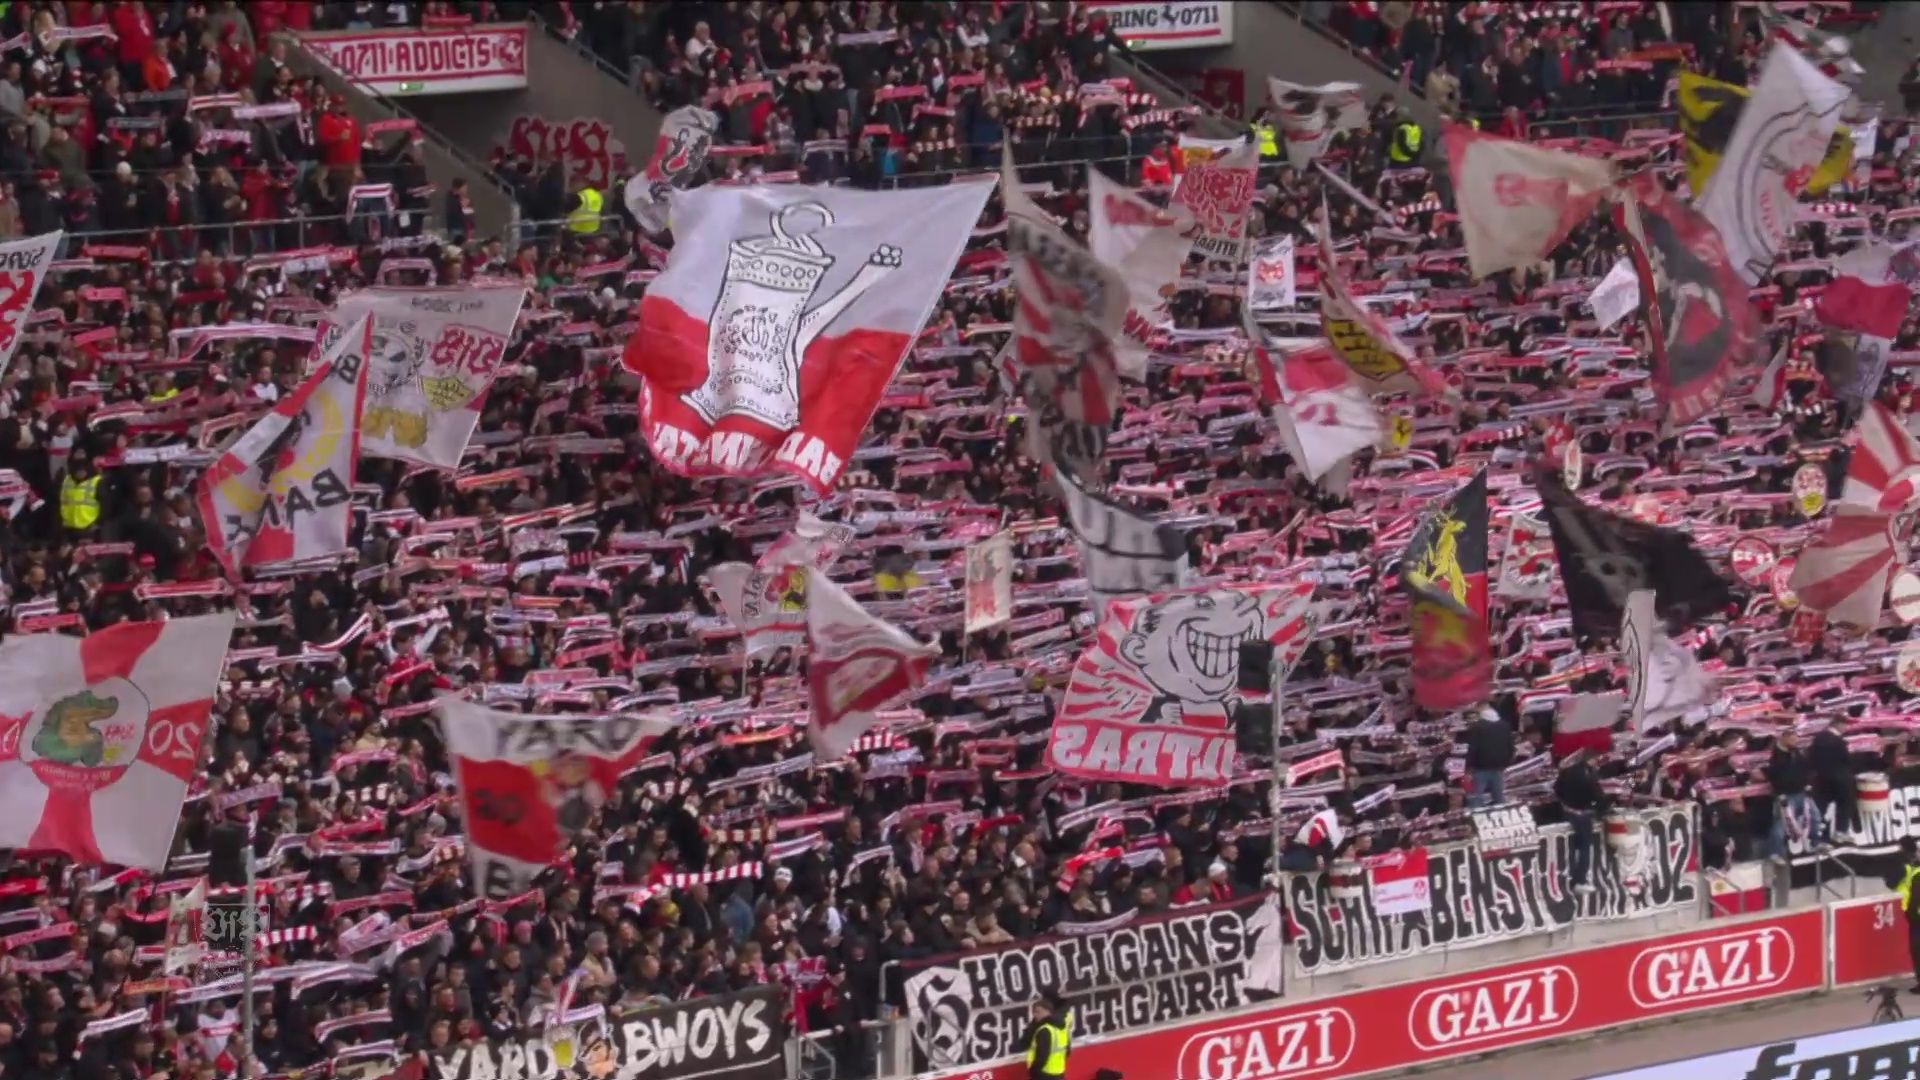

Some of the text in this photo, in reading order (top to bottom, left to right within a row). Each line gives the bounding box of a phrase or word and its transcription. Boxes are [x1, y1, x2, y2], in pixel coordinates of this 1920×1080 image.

[1181, 5, 1219, 26] 0711
[341, 37, 491, 75] 0711 ADDICTS
[1872, 903, 1895, 930] 34
[960, 911, 1246, 1009] HOOLIGANS
[434, 999, 772, 1080] YARD BWOYS
[968, 961, 1247, 1062] STTTGART
